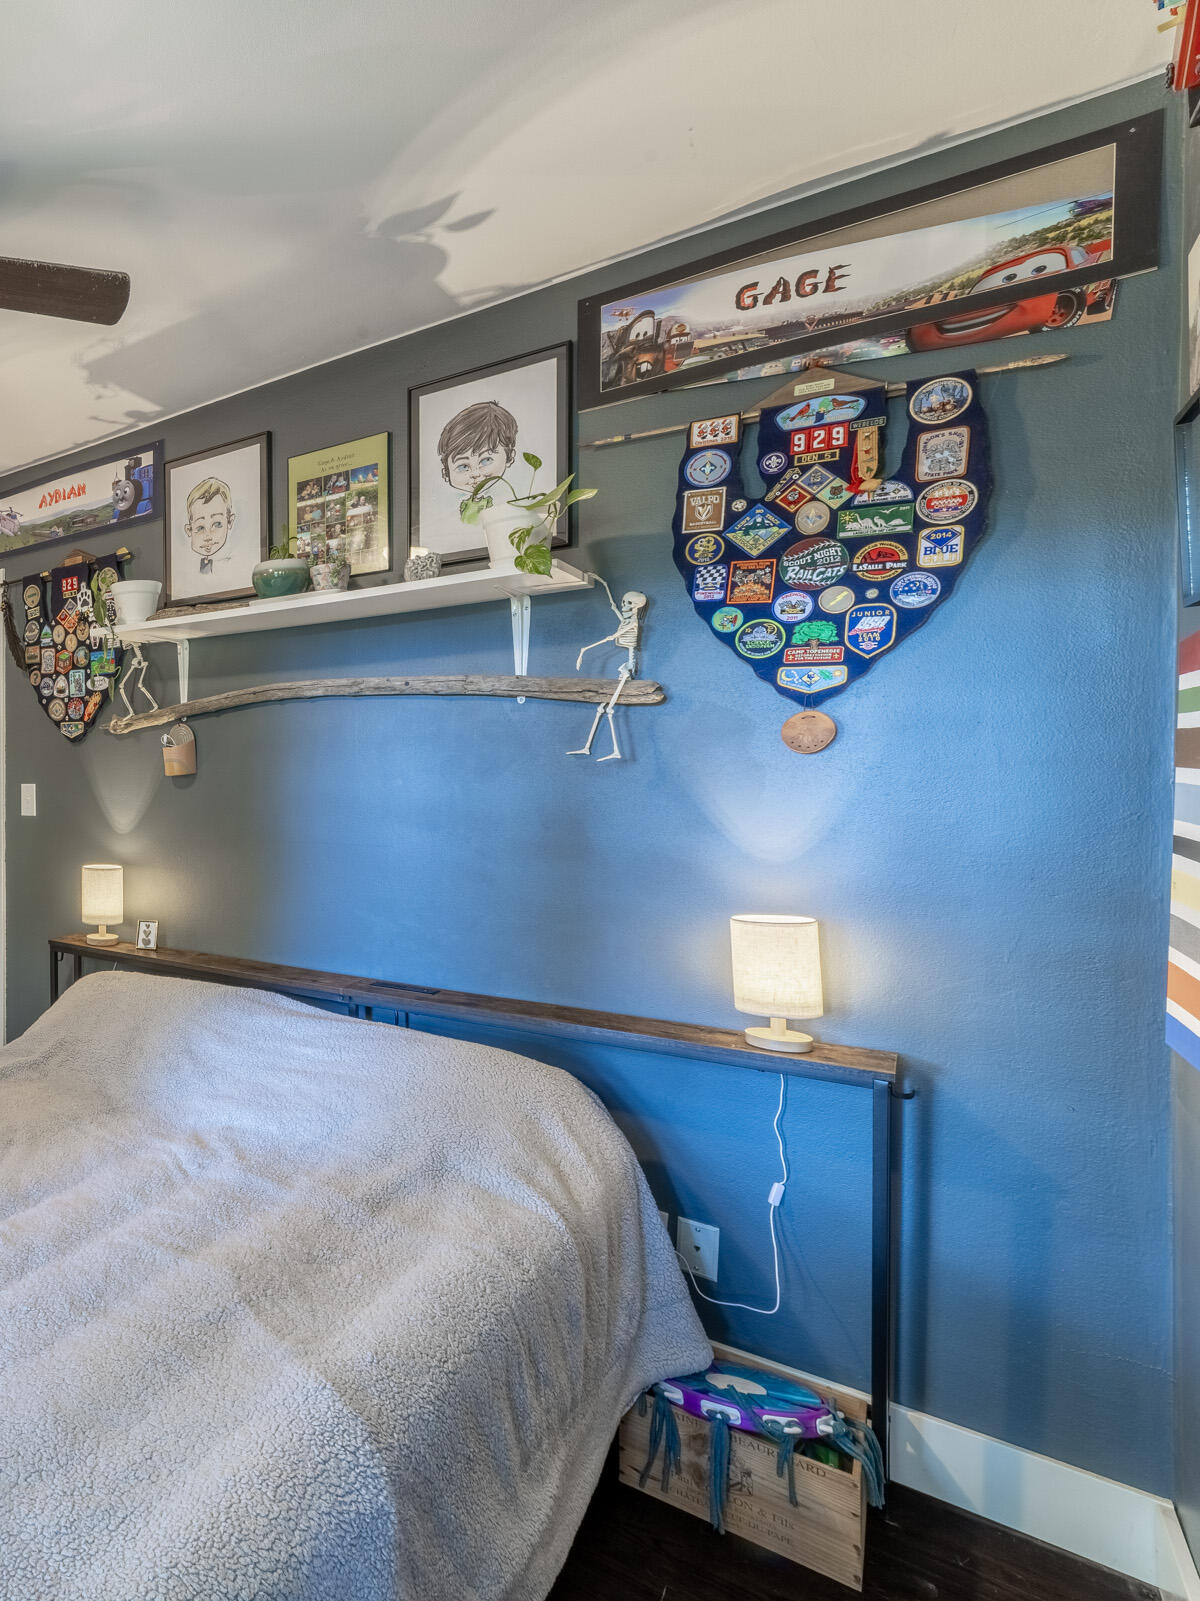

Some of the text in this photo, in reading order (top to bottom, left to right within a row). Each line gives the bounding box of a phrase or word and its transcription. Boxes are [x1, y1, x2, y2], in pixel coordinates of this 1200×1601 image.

[735, 263, 852, 311] GAGE
[793, 426, 845, 452] 929
[801, 454, 818, 463] DEN
[38, 482, 87, 509] AYDIAN
[930, 531, 952, 540] 2014
[923, 544, 958, 556] BLUE
[783, 555, 812, 567] SCOUT
[813, 547, 842, 560] NIGHT
[816, 556, 841, 565] 2012
[62, 578, 78, 591] 929
[851, 609, 891, 617] JUNIOR
